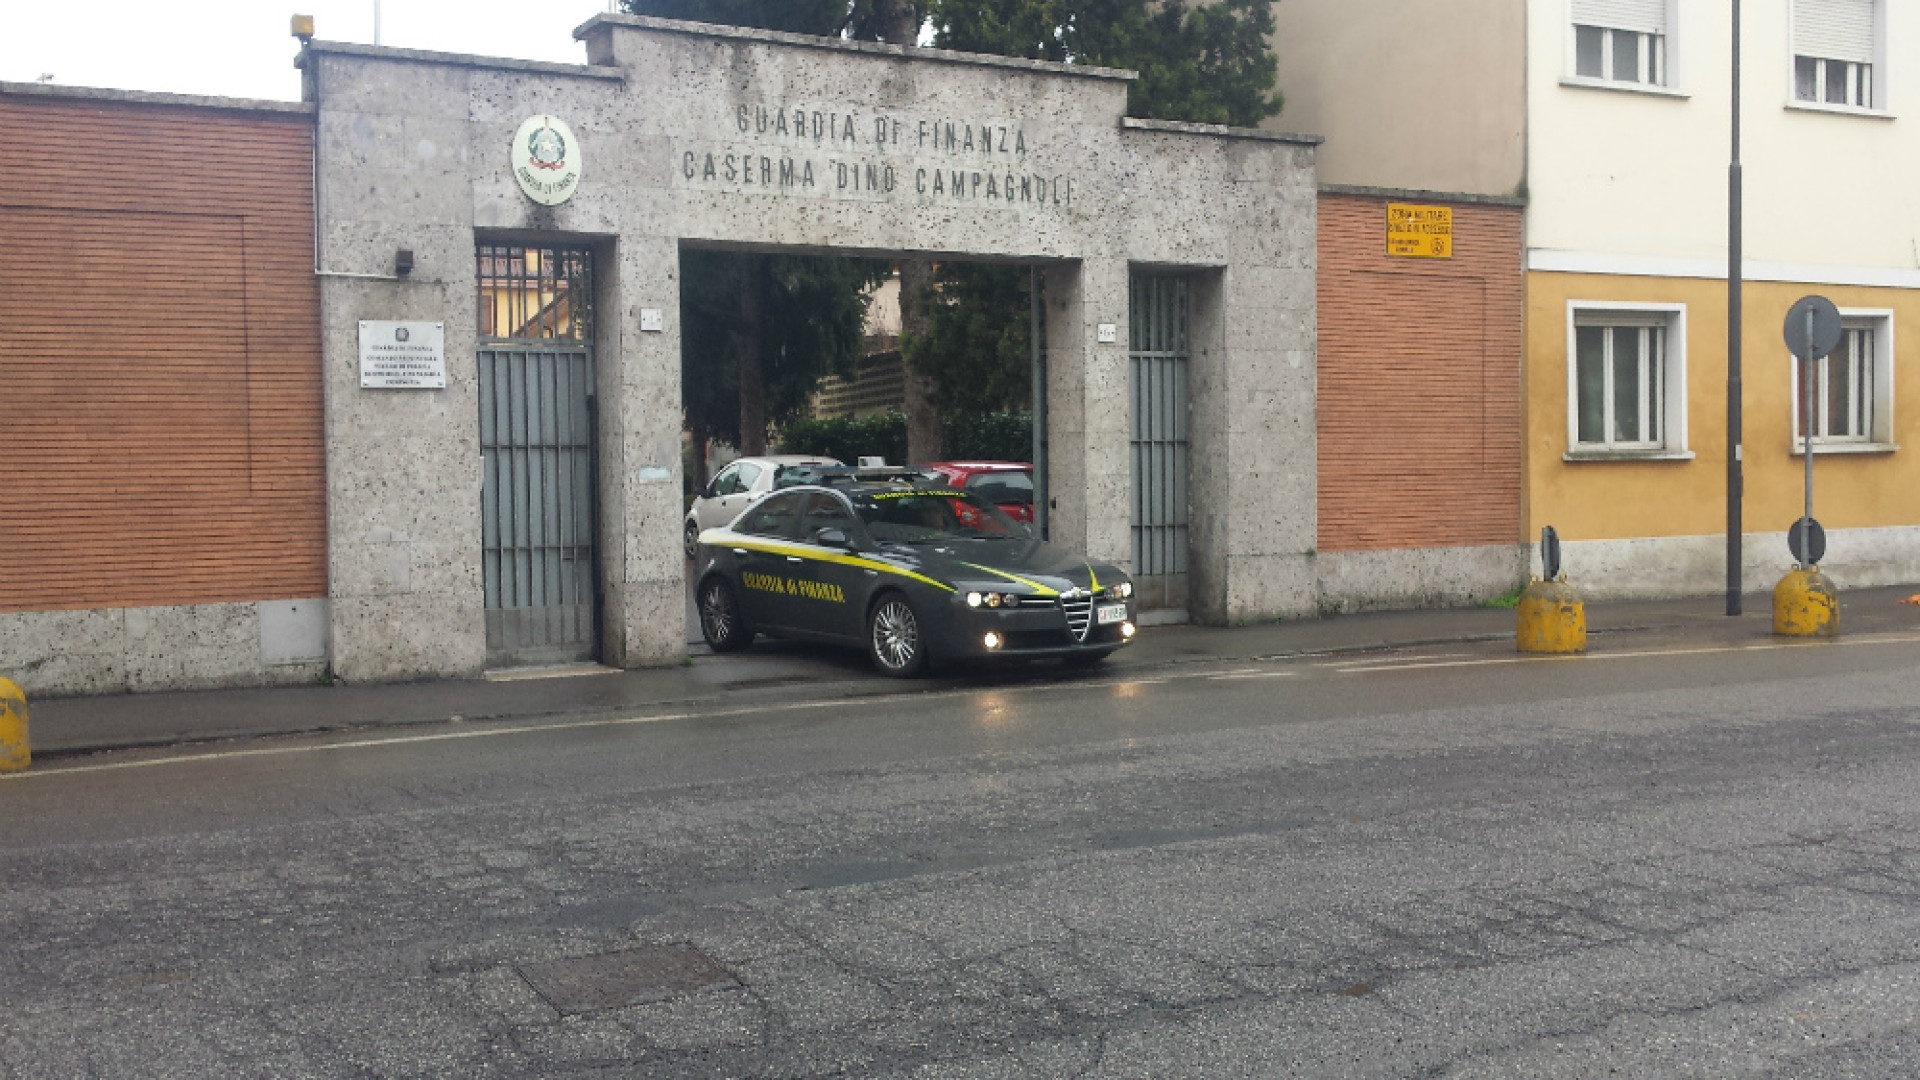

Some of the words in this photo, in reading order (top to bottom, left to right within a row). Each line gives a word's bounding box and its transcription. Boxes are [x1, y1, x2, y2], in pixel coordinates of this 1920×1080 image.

[736, 103, 856, 143] GUARDIA
[873, 116, 898, 145] DI
[919, 120, 1027, 156] FINANZA
[682, 150, 815, 187] CASERMA
[916, 167, 1071, 206] CAMPAGNOLI
